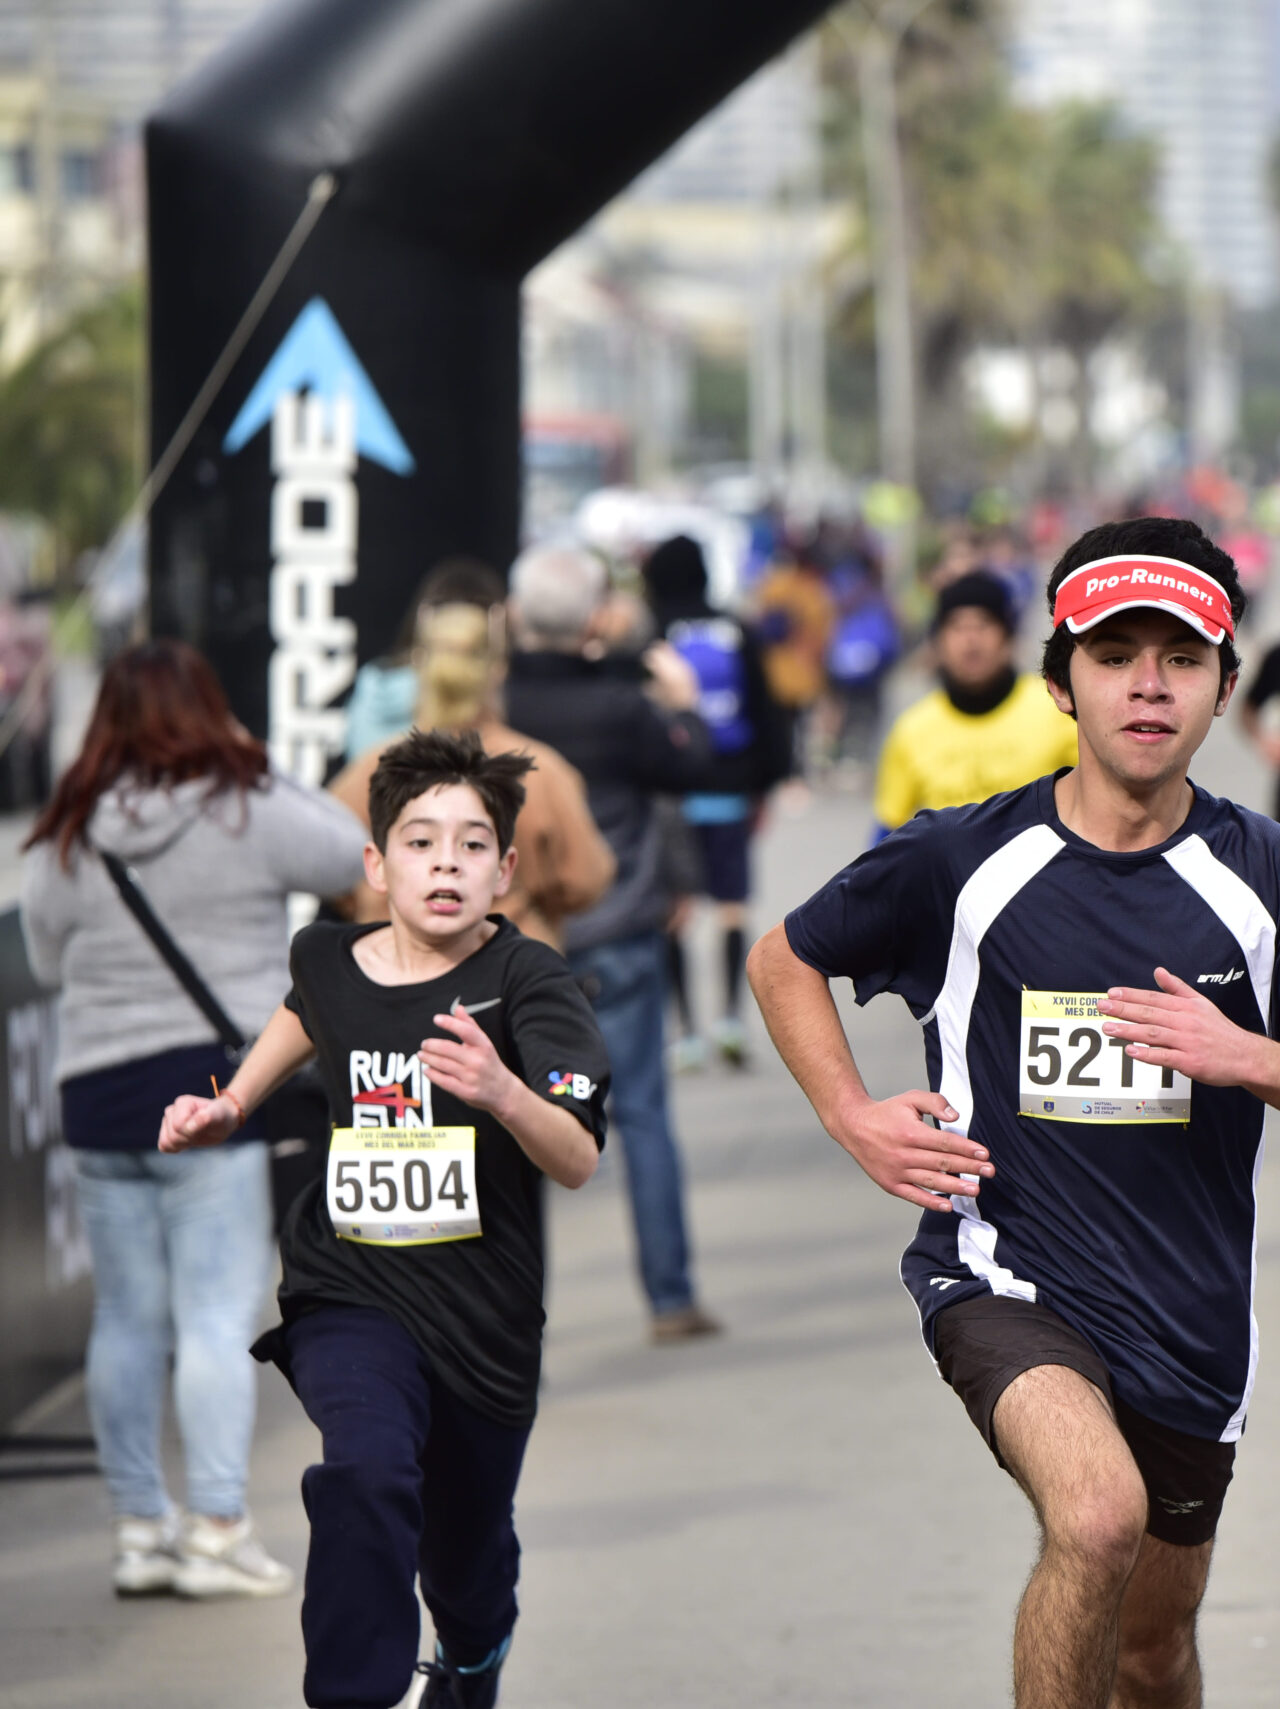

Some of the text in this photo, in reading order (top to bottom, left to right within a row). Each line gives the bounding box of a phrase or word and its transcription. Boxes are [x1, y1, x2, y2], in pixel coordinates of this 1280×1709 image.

[1086, 568, 1214, 607] Pro-Runners
[1053, 996, 1105, 1006] XXVII COR
[1065, 1007, 1085, 1016] MES
[350, 1050, 421, 1101] RUN
[352, 1083, 421, 1118] 4
[335, 1159, 469, 1213] 5504
